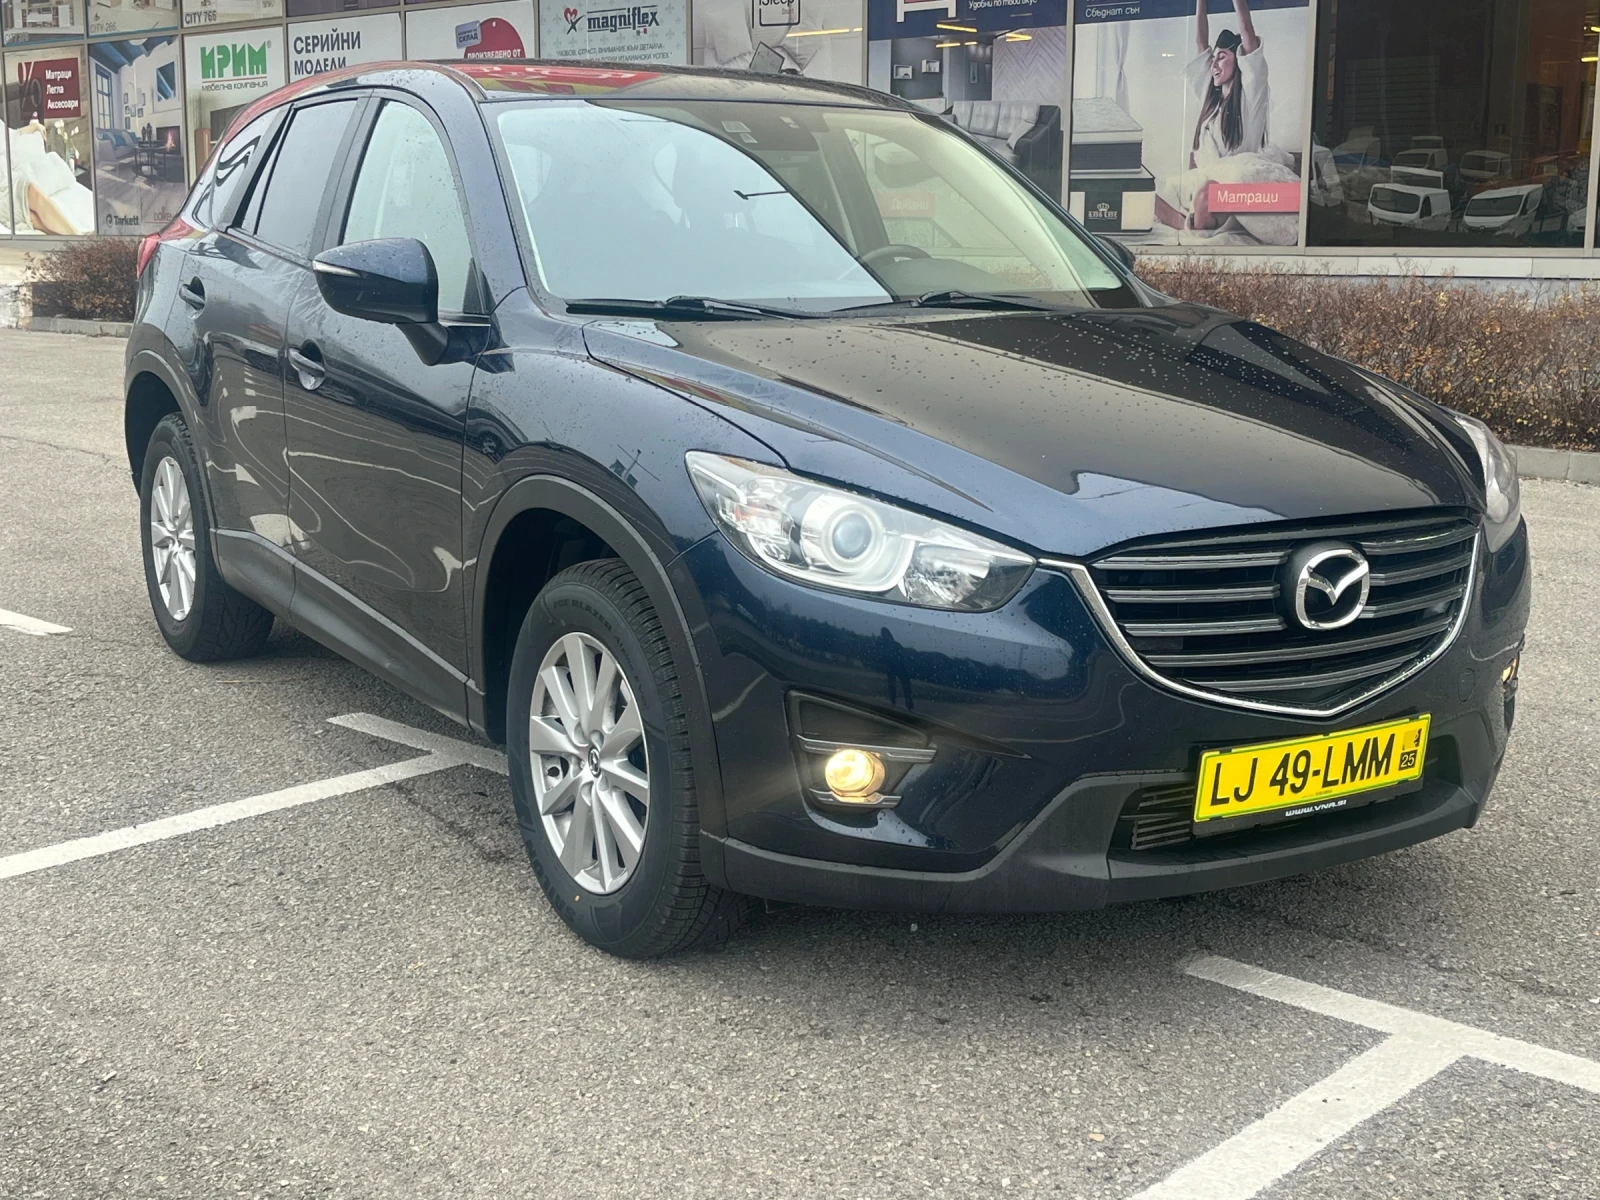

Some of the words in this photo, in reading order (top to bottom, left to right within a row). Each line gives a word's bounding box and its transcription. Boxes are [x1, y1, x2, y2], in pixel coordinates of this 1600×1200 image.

[185, 13, 203, 25] CITY
[204, 10, 217, 23] 766
[1085, 8, 1123, 18] Сбъднат
[1125, 7, 1140, 15] сън
[587, 6, 660, 33] magniflex
[90, 23, 104, 33] CITY
[293, 27, 361, 55] СЕРИЙНИ
[458, 33, 479, 43] СКЛАД
[512, 48, 521, 57] ОТ
[200, 41, 267, 79] ИРИМ
[294, 56, 346, 76] МОДЕЛИ
[45, 69, 72, 81] Матраци
[46, 84, 64, 94] Легла
[202, 83, 233, 92] мебелна
[233, 81, 268, 90] компания
[47, 99, 79, 110] Аксесоари
[1217, 190, 1279, 206] Матраци
[114, 215, 140, 226] Tarkett
[571, 599, 613, 632] BLAZER
[1400, 753, 1416, 769] 25
[1210, 757, 1258, 807] LJ
[1269, 733, 1396, 797] 49-LMM
